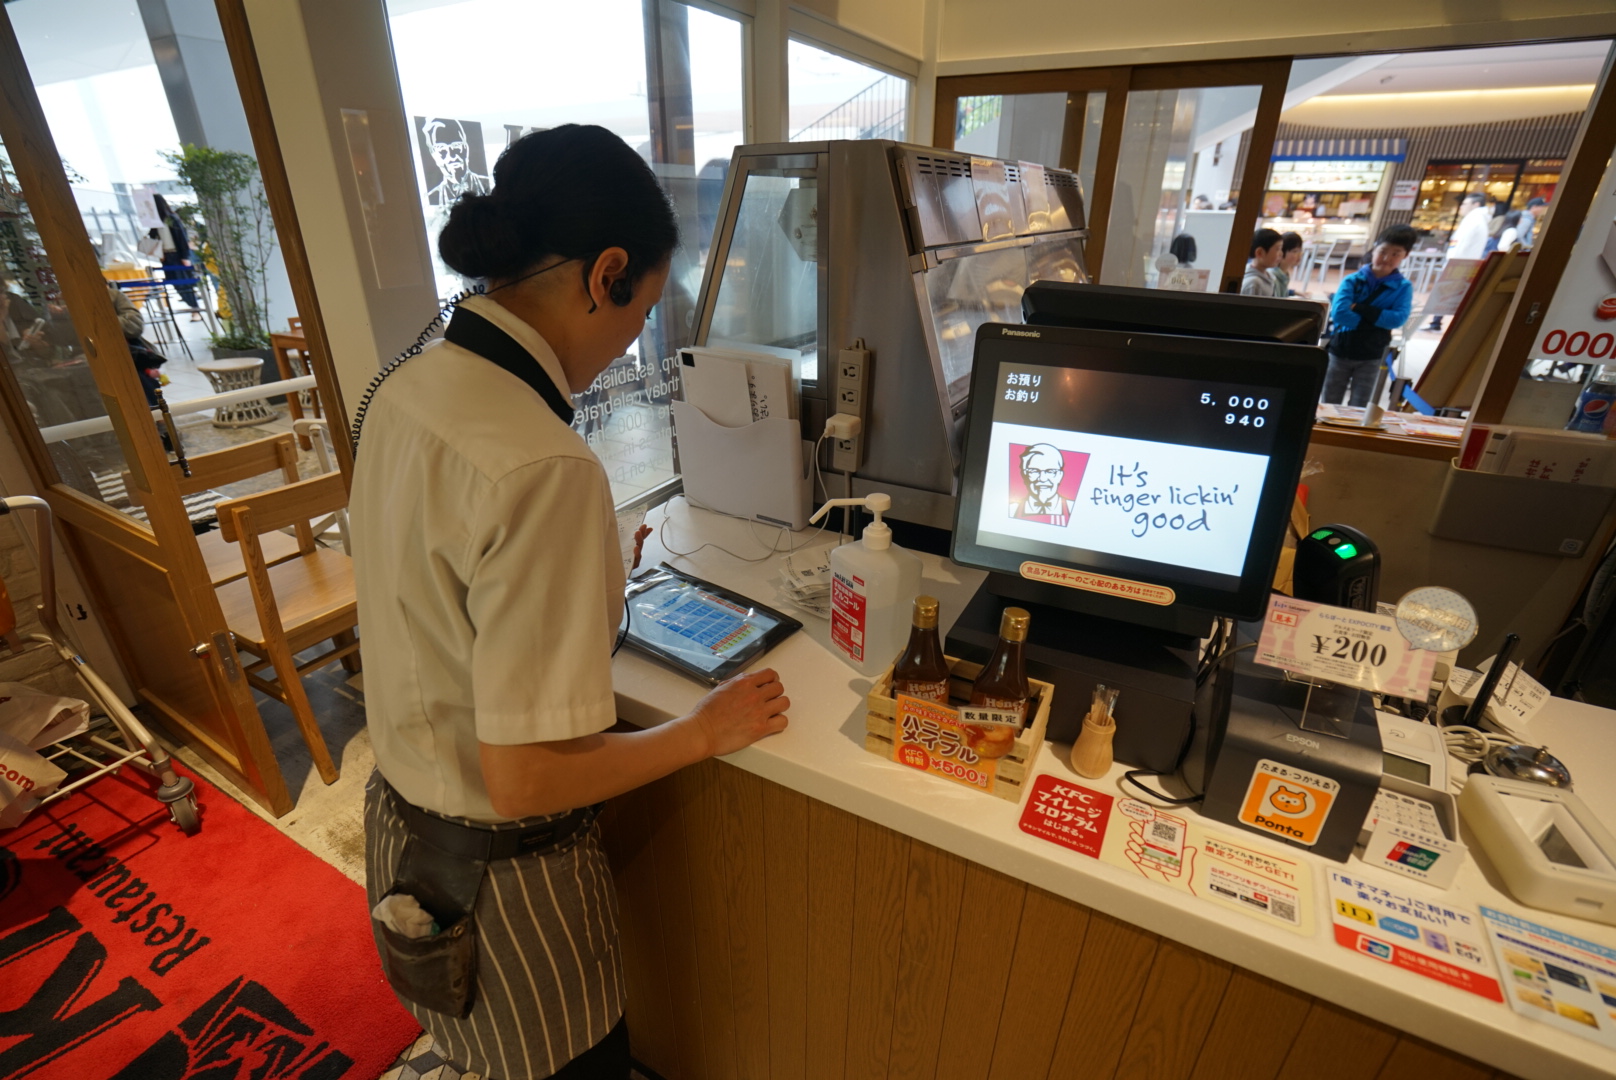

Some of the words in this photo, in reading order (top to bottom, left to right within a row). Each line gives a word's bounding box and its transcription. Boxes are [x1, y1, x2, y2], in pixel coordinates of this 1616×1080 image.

[1002, 328, 1041, 338] Panasonic
[1006, 372, 1042, 387] お預り
[1004, 388, 1040, 403] お釣り
[1224, 413, 1266, 428] 940
[1109, 462, 1148, 487] It's
[1090, 487, 1161, 513] finger
[1169, 484, 1239, 506] lickin'
[1131, 509, 1212, 538] good
[1026, 566, 1142, 595] 食品アレルギーのご心配のある方は
[1274, 613, 1294, 625] 見本
[1318, 612, 1347, 624] ららぽーと
[1348, 618, 1380, 631] EXPOCITY
[1310, 634, 1387, 668] ¥200
[908, 678, 947, 692] Honey
[902, 714, 959, 740] ハニー
[964, 711, 1017, 724] 数量限定
[902, 730, 978, 763] メイプル
[1286, 733, 1320, 750] EPSON
[904, 748, 924, 759] KFC
[1038, 790, 1103, 819] マイレージ
[1051, 784, 1095, 805] KFC
[1033, 801, 1098, 834] プログラム
[1043, 818, 1084, 839] はじまる。
[1205, 845, 1295, 881] 限定クーポンGET!
[35, 823, 212, 978] Restaurant
[1332, 872, 1471, 925] 「電子マネー」ご利用で
[1455, 947, 1482, 964] Edy
